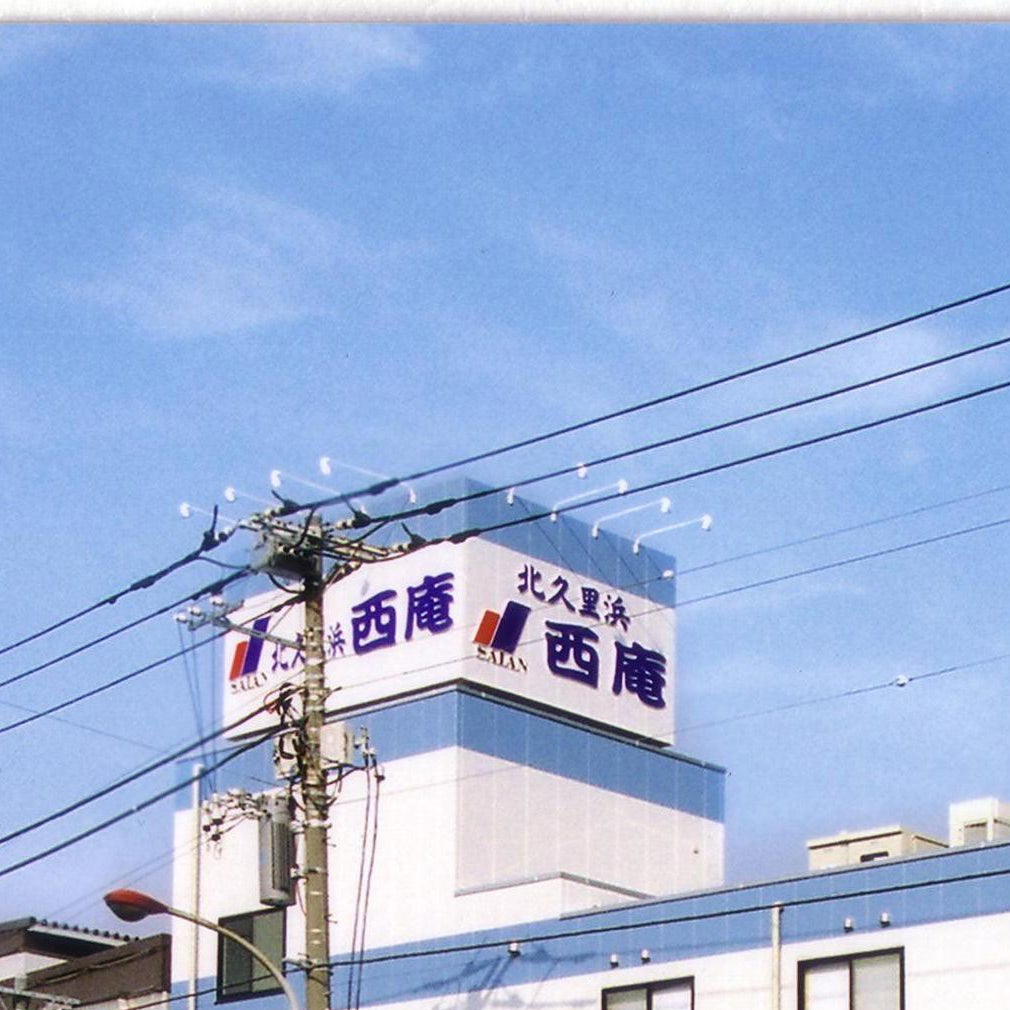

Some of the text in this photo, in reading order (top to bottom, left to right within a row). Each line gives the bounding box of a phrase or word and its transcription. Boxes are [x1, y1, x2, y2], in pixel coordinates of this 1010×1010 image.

[351, 571, 455, 656] 西庵
[517, 563, 631, 633] 北久里浜
[545, 620, 667, 710] 西庵
